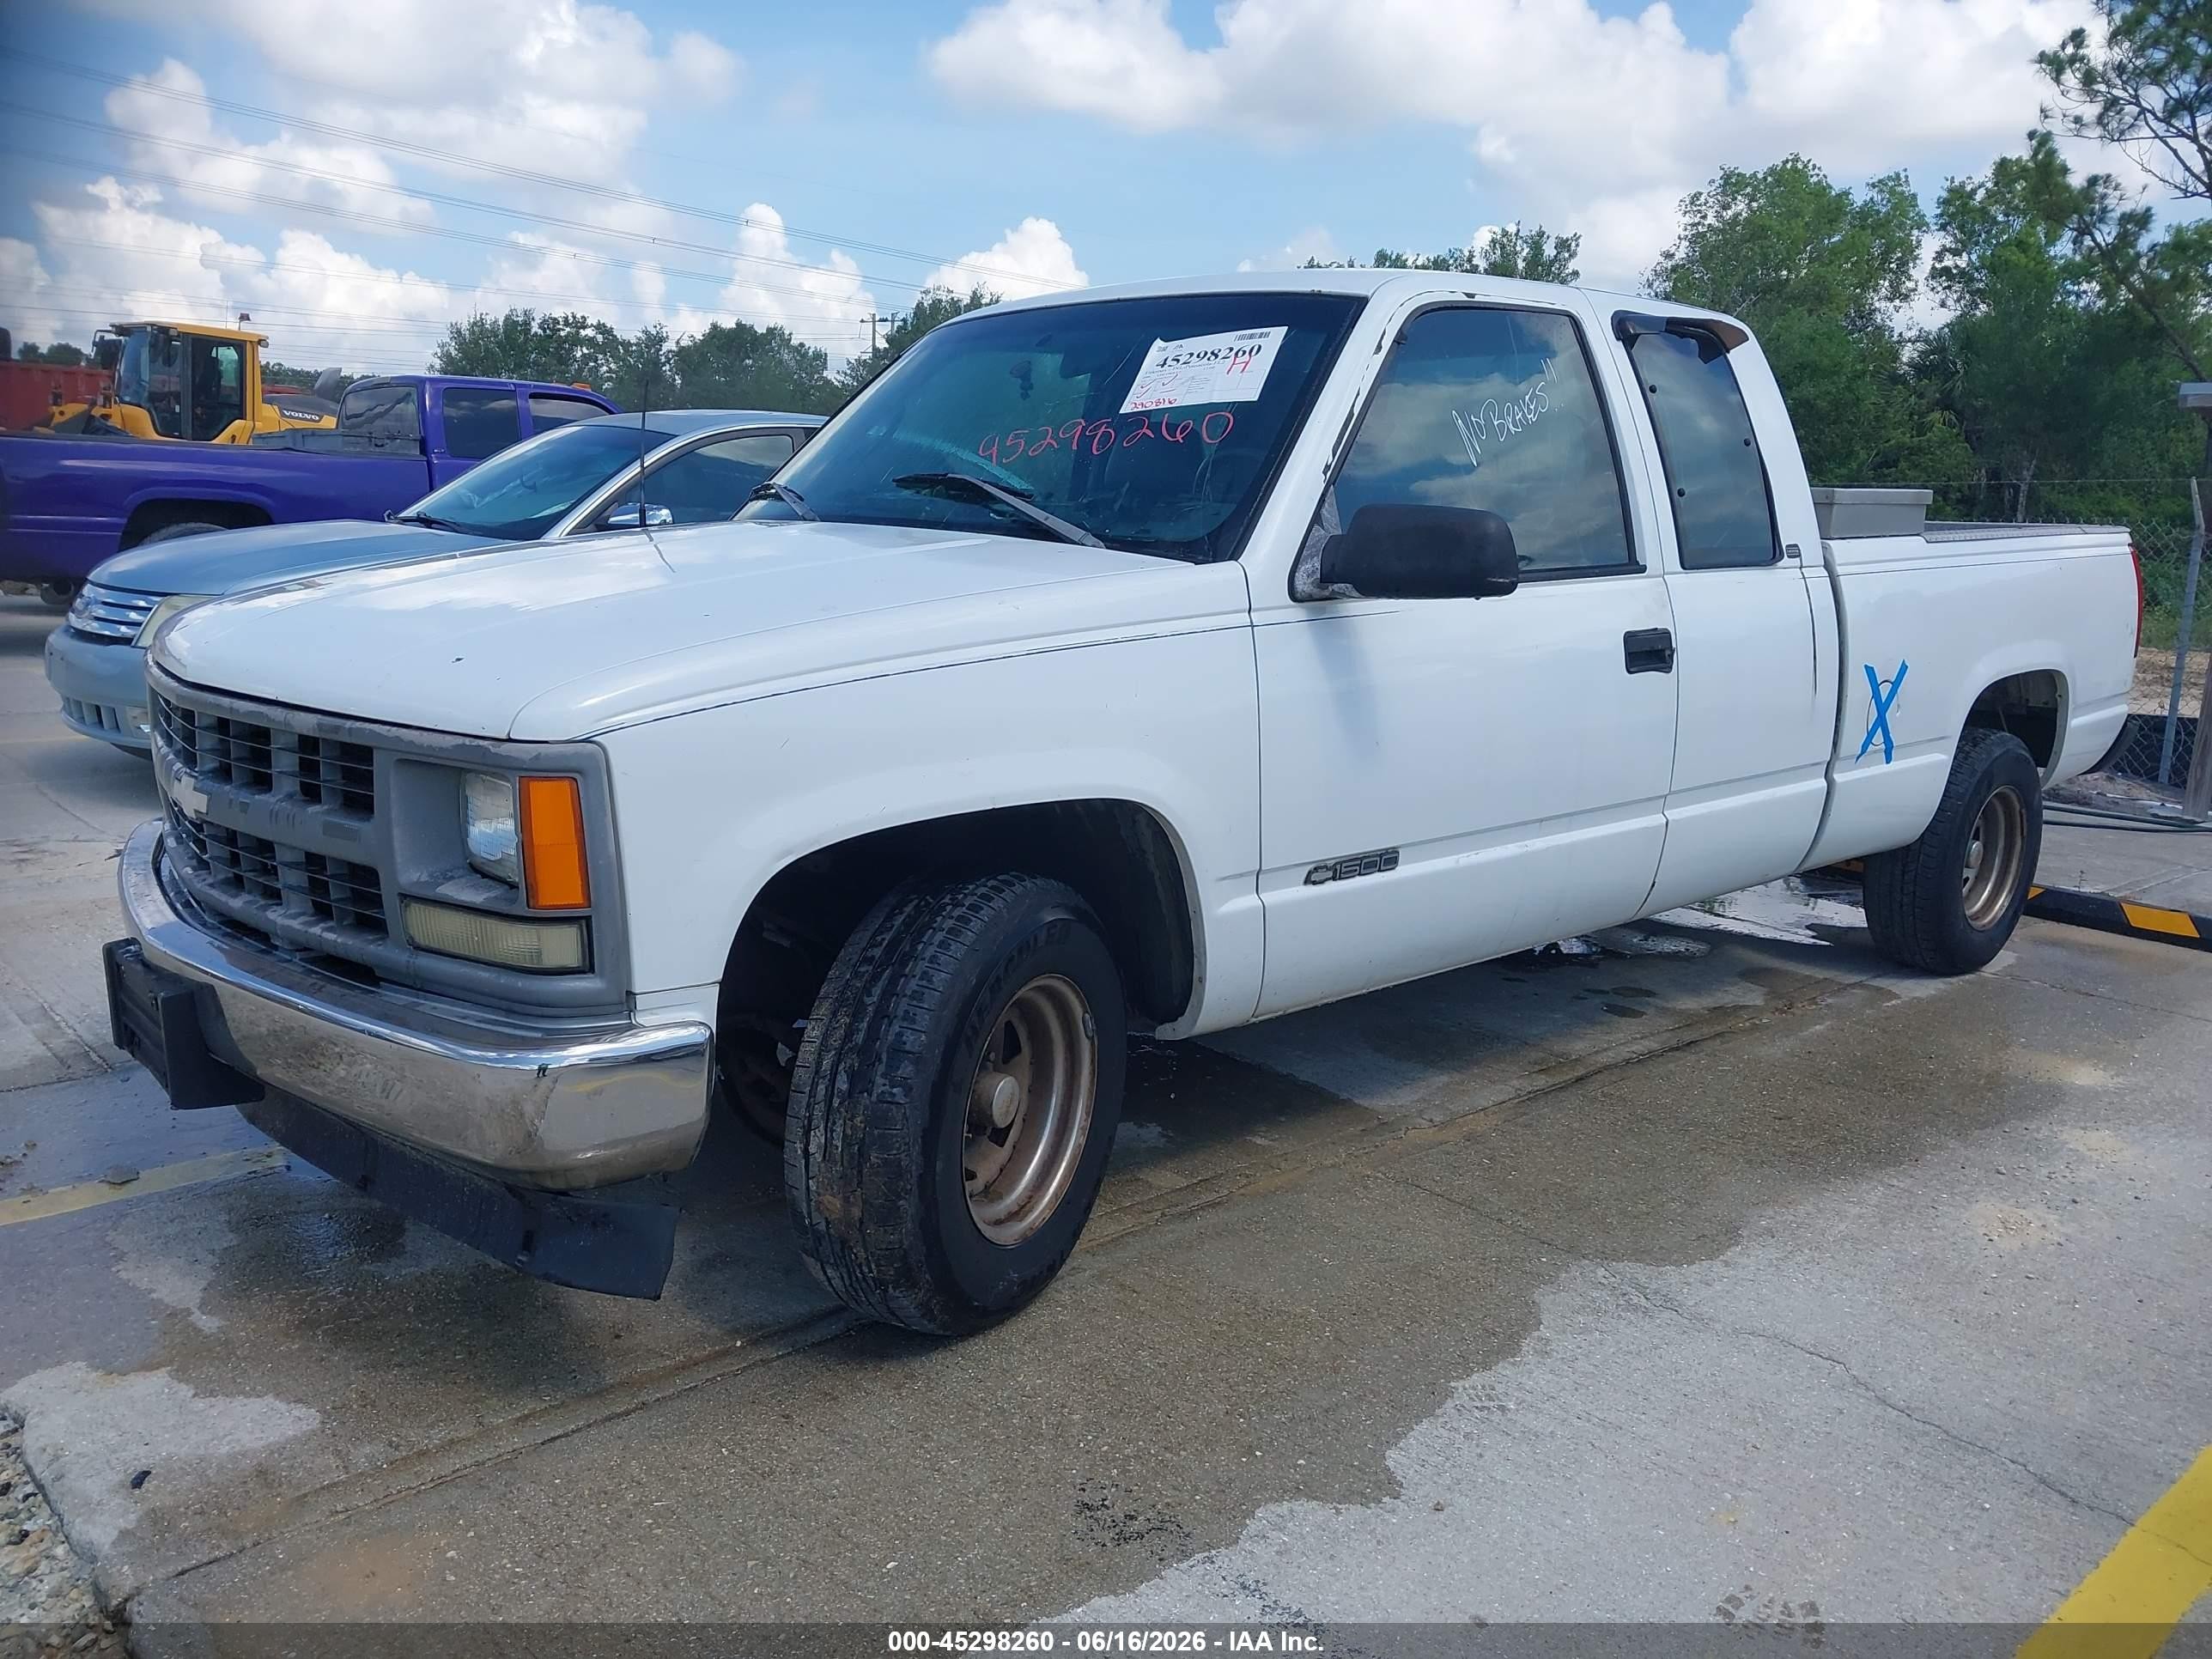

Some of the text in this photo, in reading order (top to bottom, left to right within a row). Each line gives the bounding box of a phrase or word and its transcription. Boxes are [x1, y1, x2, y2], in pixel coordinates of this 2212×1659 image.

[1156, 343, 1262, 368] 45298260
[283, 410, 320, 421] VOLVO
[1451, 410, 1486, 467] NO
